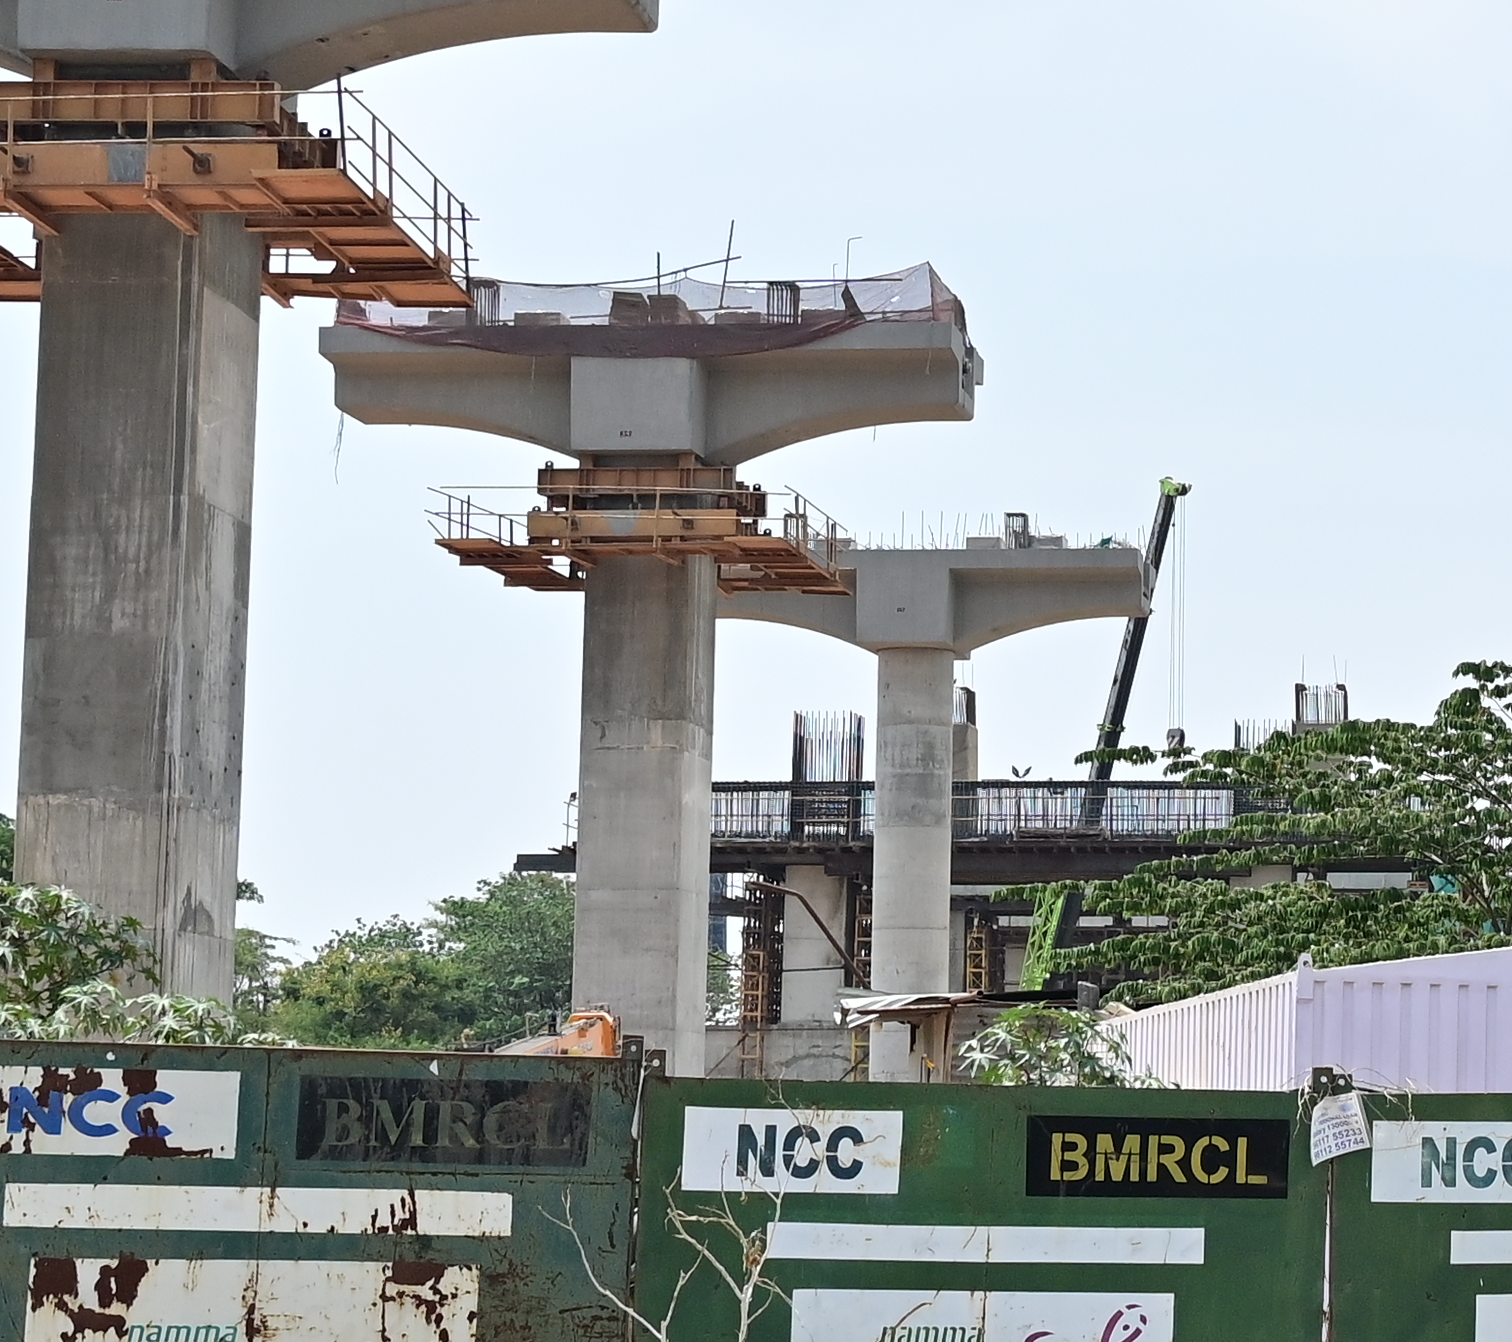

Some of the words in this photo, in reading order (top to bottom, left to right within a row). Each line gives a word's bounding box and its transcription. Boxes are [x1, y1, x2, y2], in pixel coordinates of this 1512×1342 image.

[7, 1086, 175, 1138] NCC
[321, 1099, 573, 1153] BMRCL
[1332, 1128, 1363, 1141] 55233
[737, 1124, 863, 1179] NCC
[1049, 1132, 1268, 1185] BMRCL
[1335, 1137, 1365, 1151] 55744
